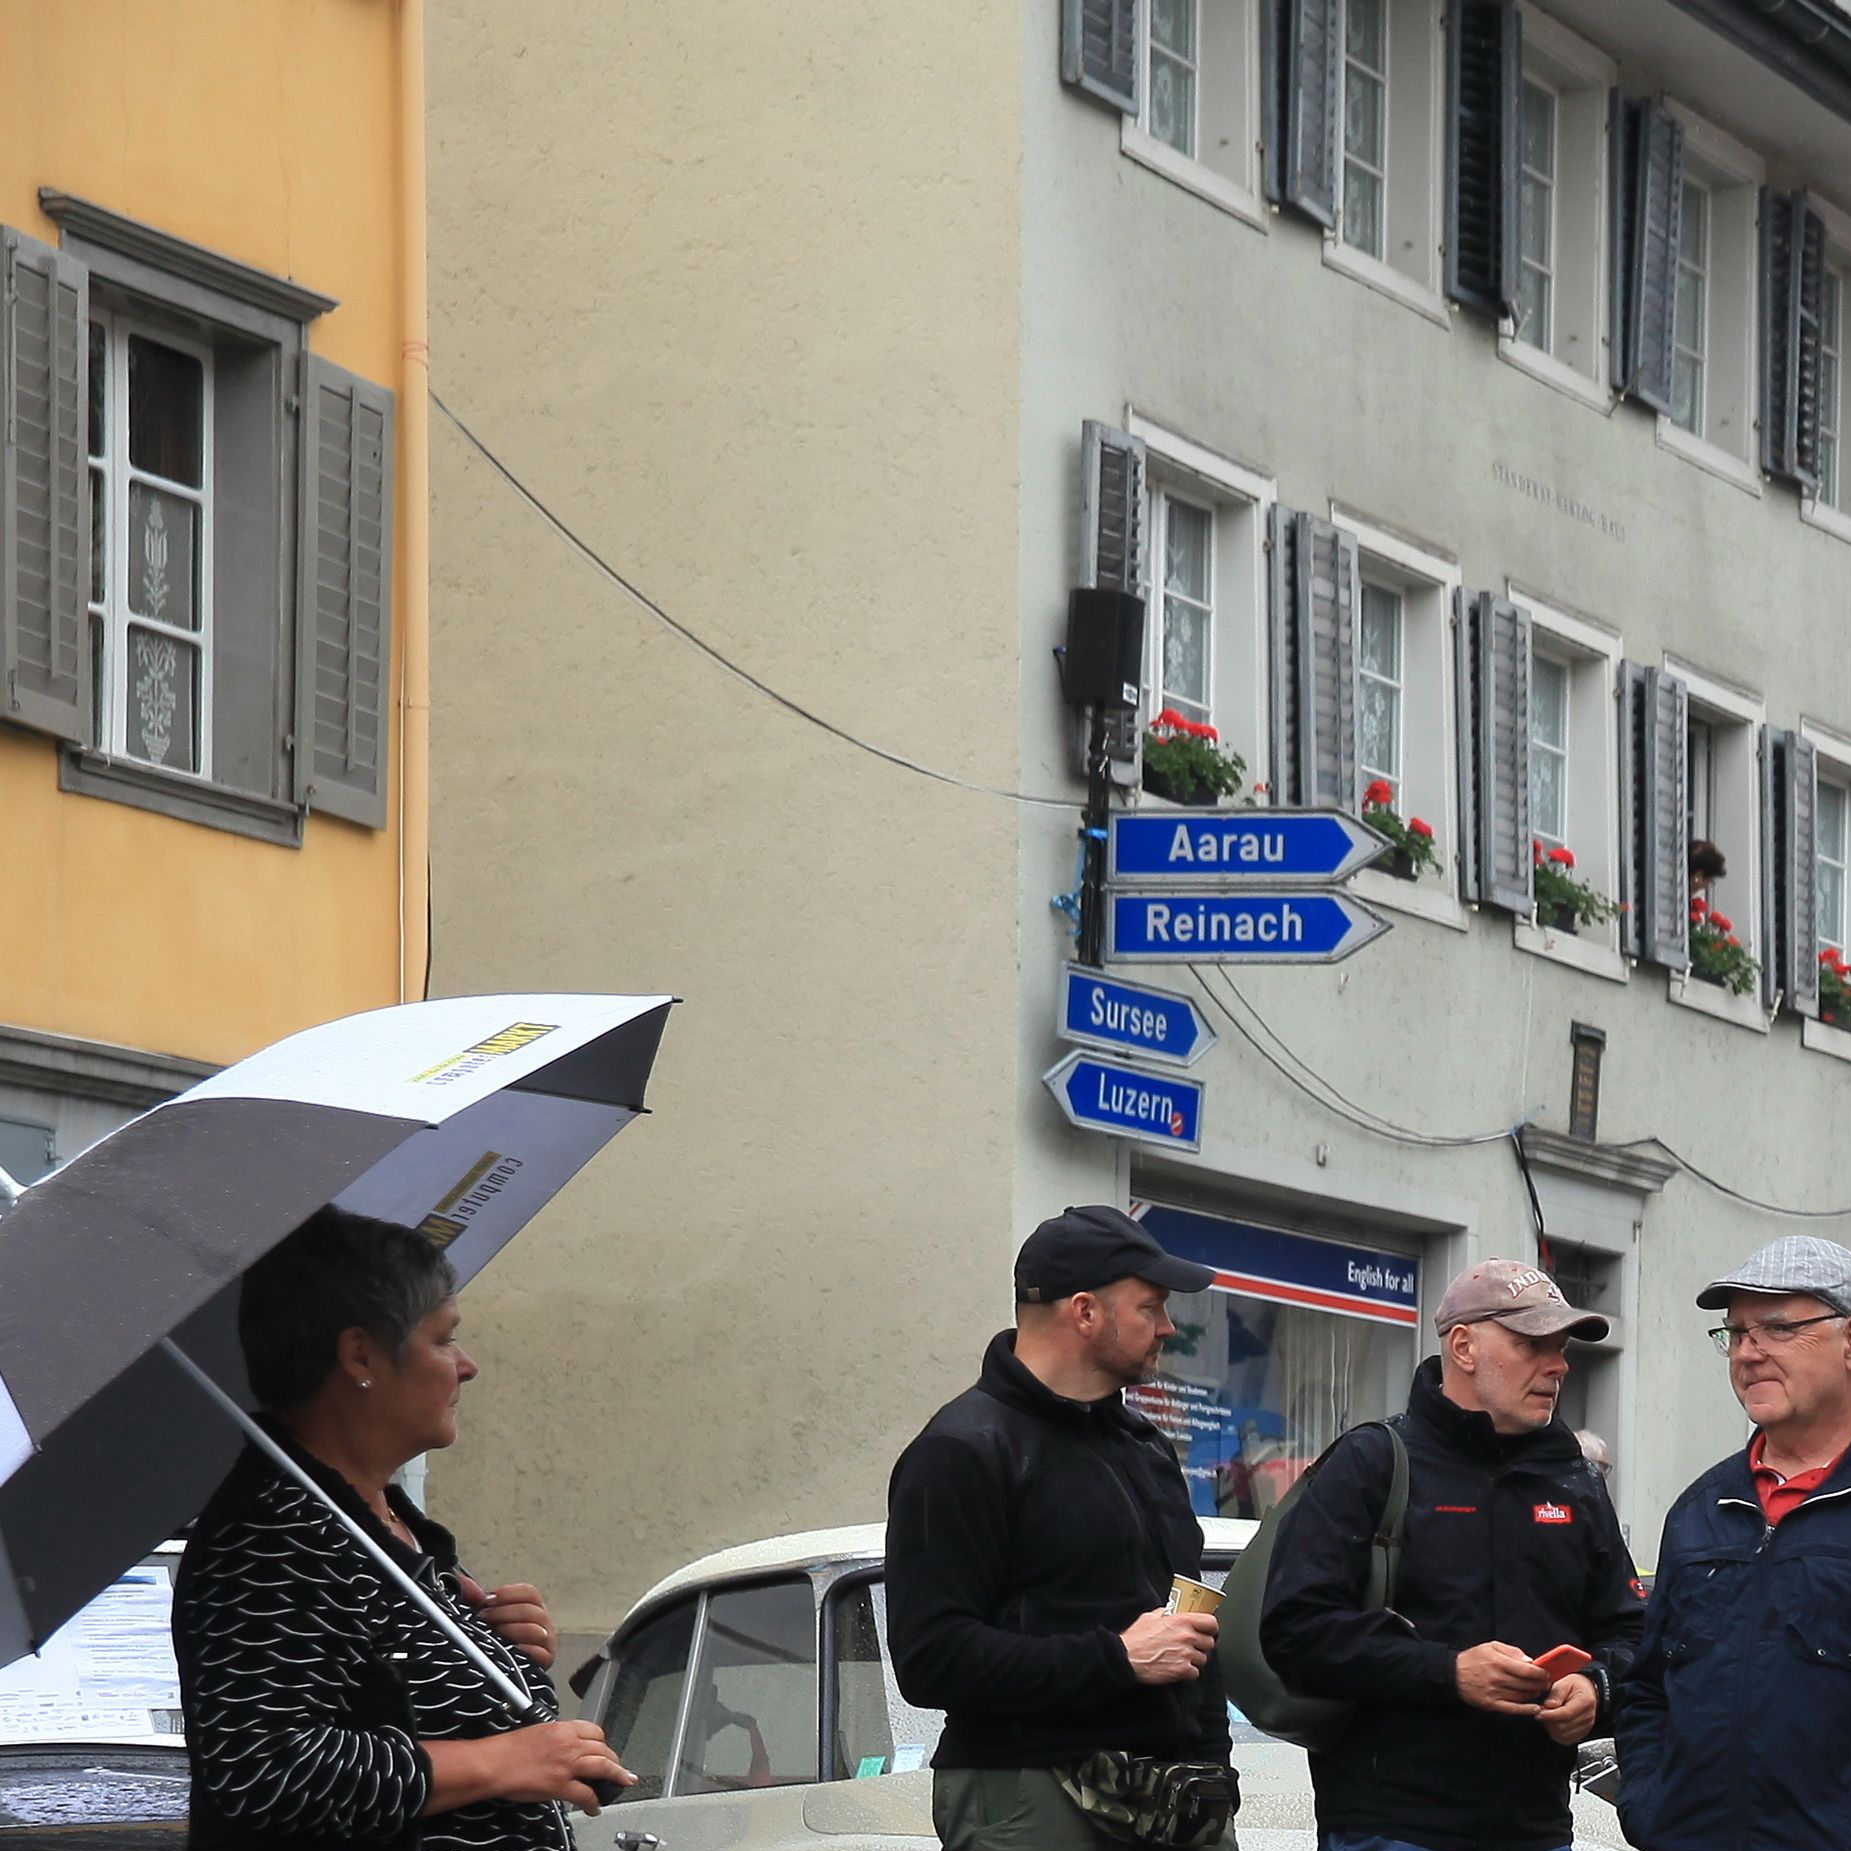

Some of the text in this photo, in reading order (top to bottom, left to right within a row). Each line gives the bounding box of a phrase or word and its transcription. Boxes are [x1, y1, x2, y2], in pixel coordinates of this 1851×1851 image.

[1168, 824, 1285, 862] Aarau
[1146, 903, 1303, 943] Reinach
[1090, 988, 1167, 1041] Sursee
[1098, 1072, 1173, 1124] Luzern
[1347, 1260, 1415, 1294] English for all
